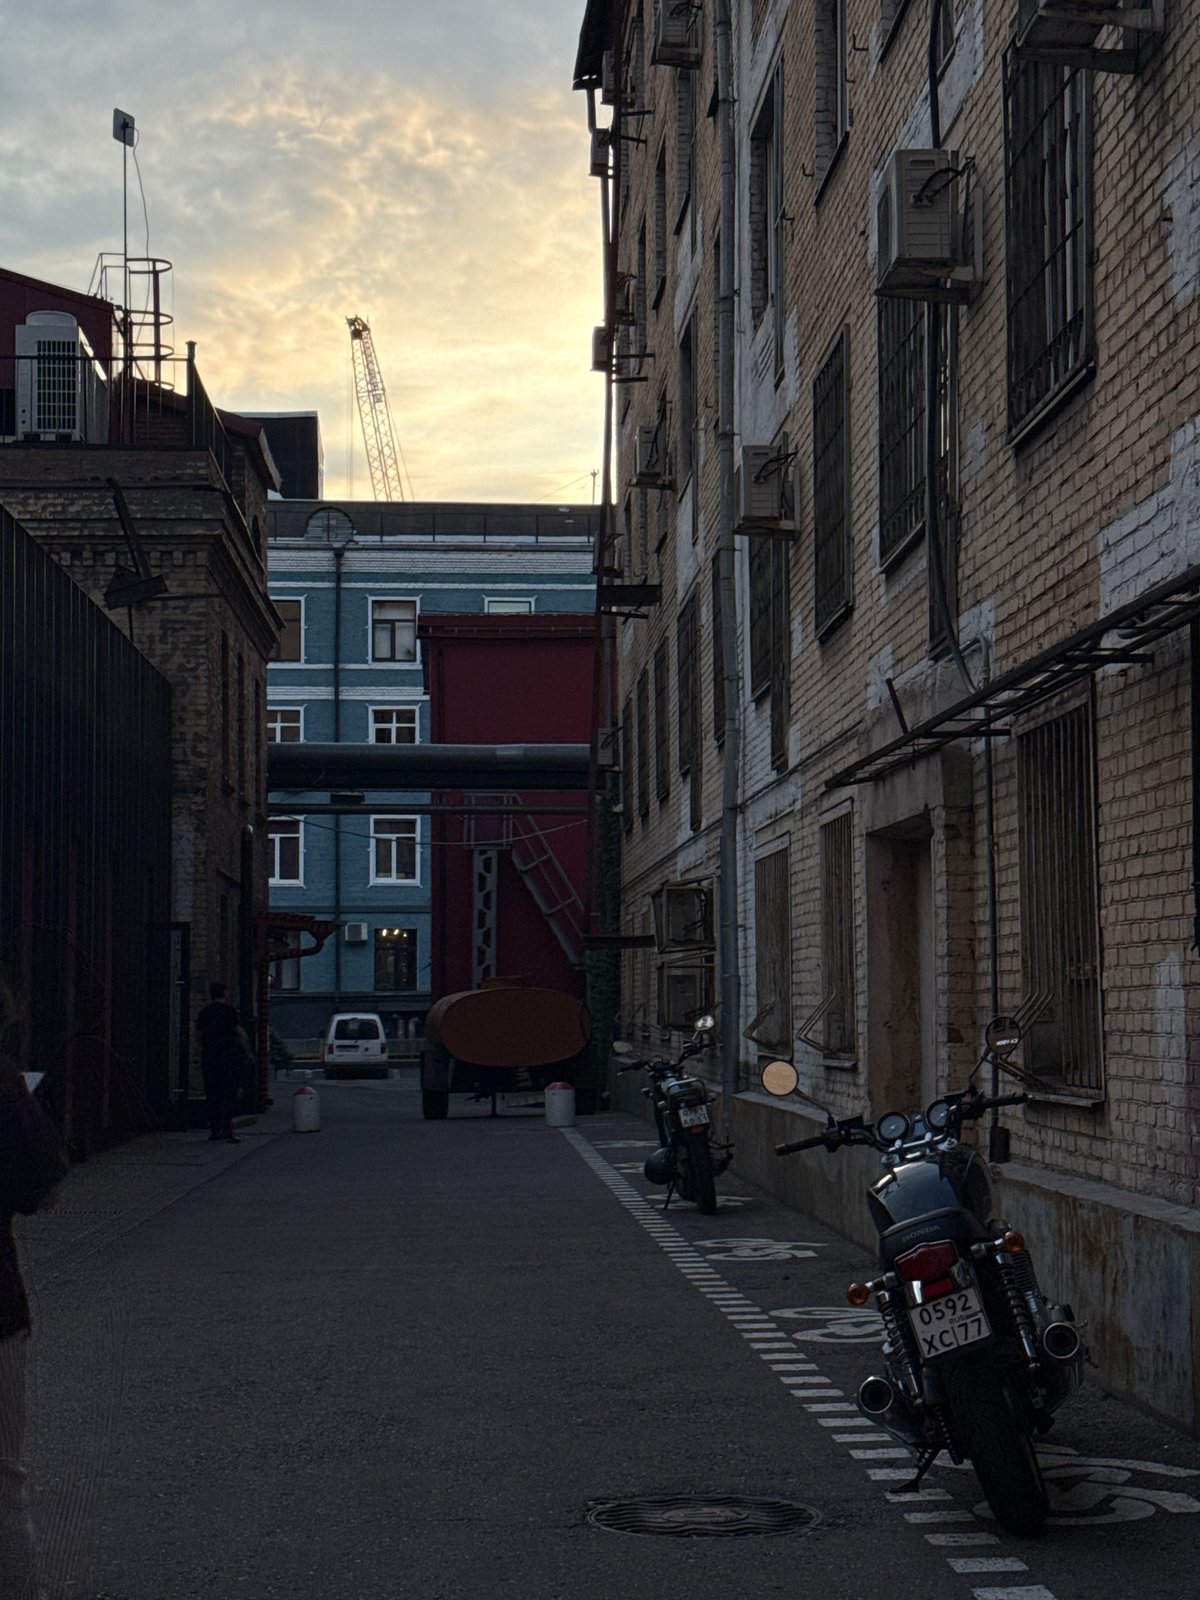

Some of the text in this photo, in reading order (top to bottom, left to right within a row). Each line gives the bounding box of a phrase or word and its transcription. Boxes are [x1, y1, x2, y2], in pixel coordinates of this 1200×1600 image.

[902, 1226, 941, 1241] HONDA
[920, 1294, 972, 1324] 0592
[949, 1314, 966, 1325] RUS
[922, 1318, 982, 1355] XC 77
